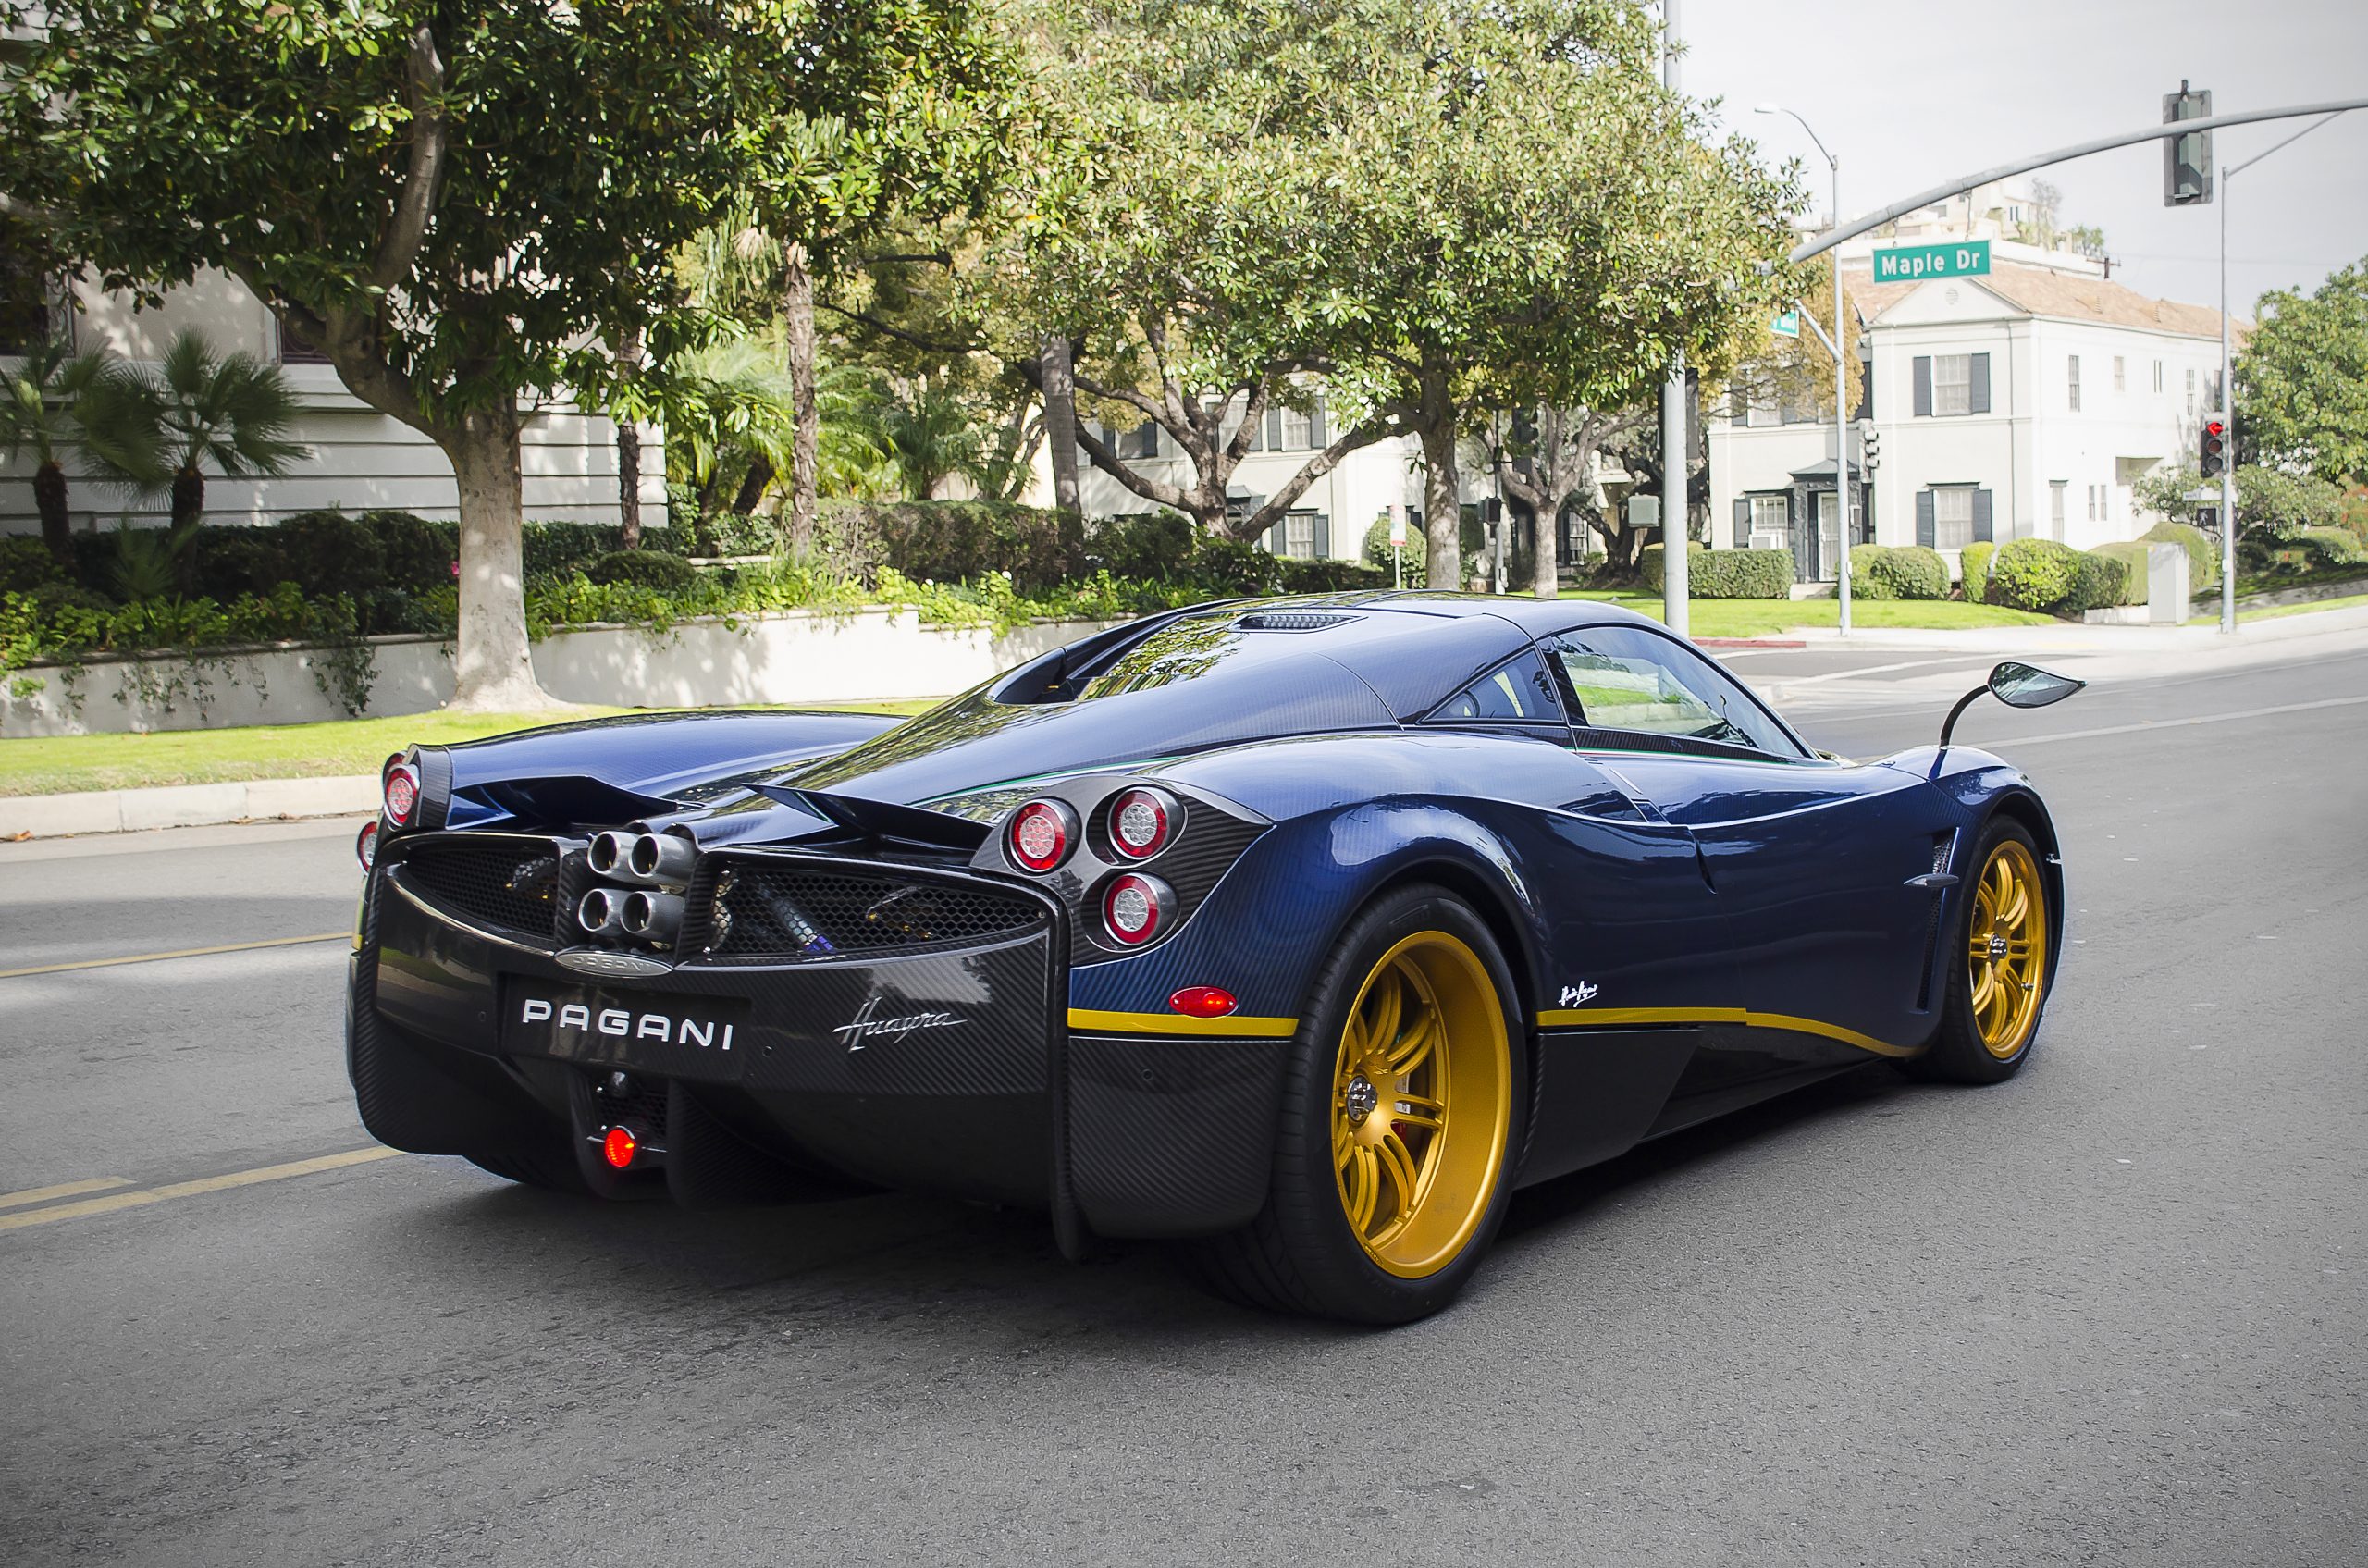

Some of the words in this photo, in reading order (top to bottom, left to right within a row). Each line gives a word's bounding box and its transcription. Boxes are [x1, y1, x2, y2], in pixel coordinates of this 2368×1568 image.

[1881, 253, 1945, 277] Maple
[1956, 249, 1980, 269] Dr
[522, 999, 733, 1050] PAGANI
